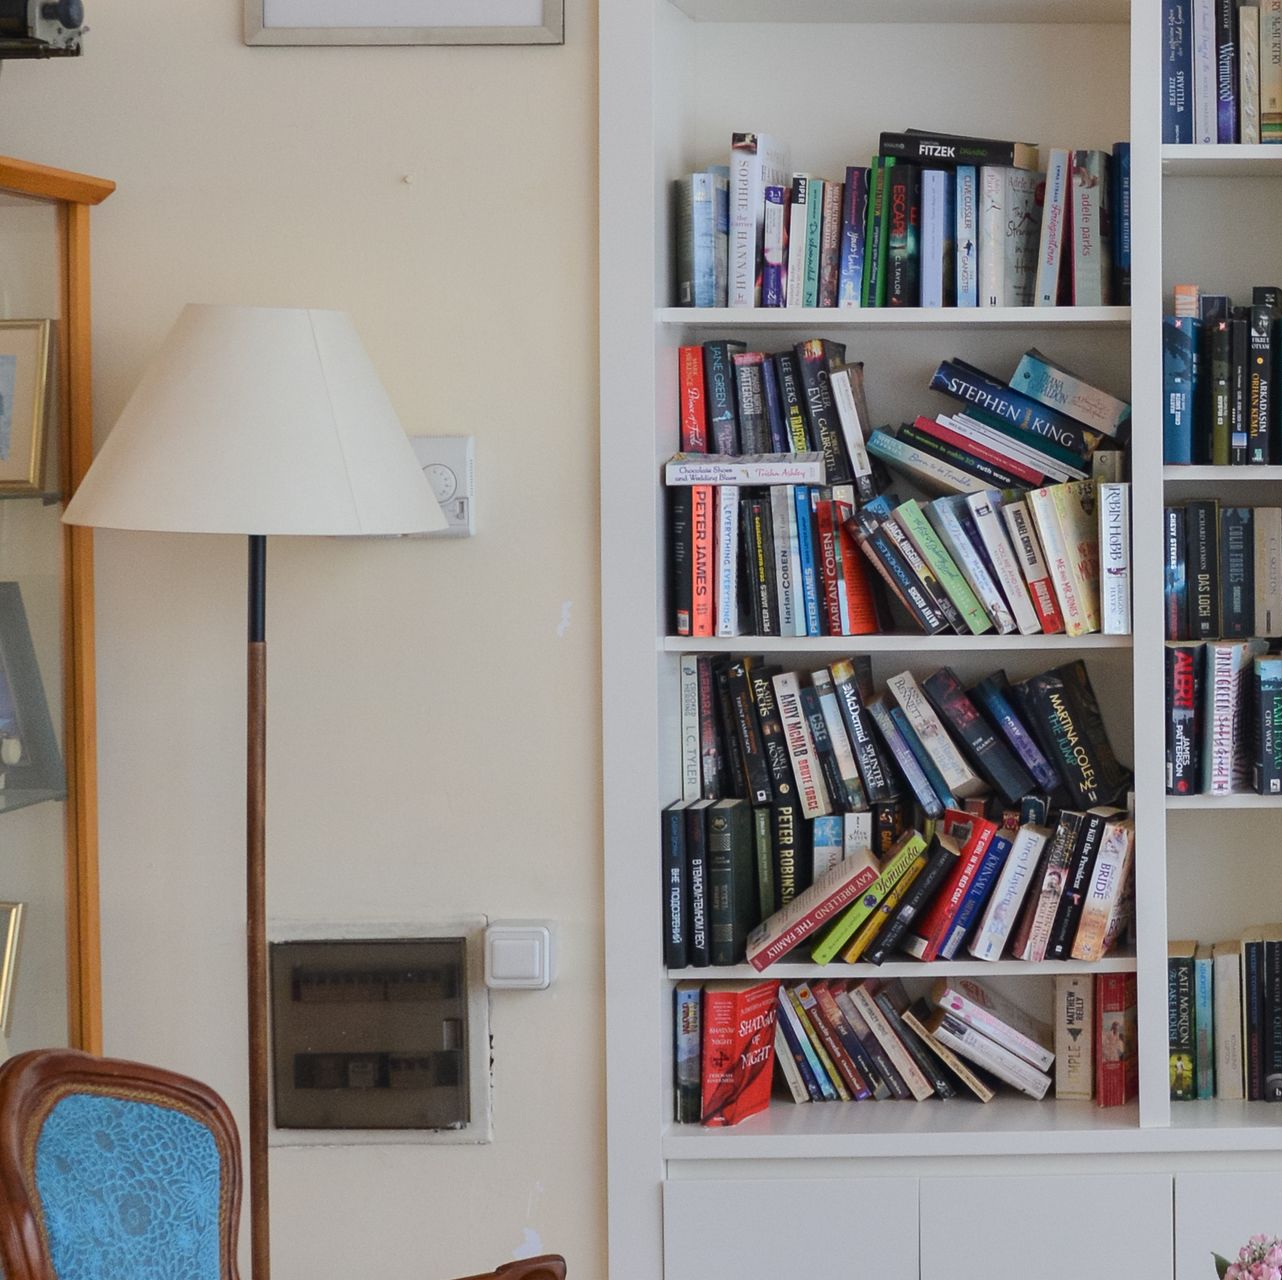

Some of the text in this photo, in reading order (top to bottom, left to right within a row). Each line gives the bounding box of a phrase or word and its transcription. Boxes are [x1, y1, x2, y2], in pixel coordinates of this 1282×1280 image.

[1219, 42, 1234, 102] Wormwood
[919, 144, 955, 158] FITZEK
[739, 160, 749, 212] SOPHIE
[1081, 194, 1092, 256] adele parks
[736, 231, 748, 290] HANNAH
[711, 346, 727, 408] JANE GREEN
[741, 367, 753, 415] PATTERSON
[784, 373, 797, 403] WEEKS
[1252, 373, 1260, 405] ORHAN
[808, 387, 823, 417] EVIL
[948, 378, 1021, 420] STEPHEN
[1032, 419, 1074, 447] KING
[818, 418, 837, 471] GALBRAITH
[976, 463, 1011, 483] ruth ware
[696, 491, 706, 597] PETER JAMES
[886, 521, 923, 571] JACK HIGGINS
[1012, 510, 1037, 566] MICHAEL CRICHTON
[779, 550, 791, 623] Harlan COBEN
[823, 532, 841, 632] HARLAN COBEN
[1198, 574, 1210, 616] DAS LOCH
[810, 603, 818, 633] PETER
[754, 679, 769, 717] REICHS
[845, 688, 869, 743] McDermid
[1050, 694, 1079, 746] MARTINA
[780, 694, 808, 757] ANDY McNAB
[687, 746, 697, 785] TYLER
[864, 743, 885, 789] SPLINTER
[1175, 725, 1183, 777] PATTERSON
[798, 759, 819, 811] BRUTE FORCE
[778, 807, 793, 845] PETER
[855, 873, 873, 888] KAY
[958, 875, 970, 889] RED
[1093, 863, 1111, 900] BRIDE
[768, 920, 814, 959] THE FAMILY
[738, 1008, 777, 1037] SHADOW
[1066, 991, 1075, 1025] MATTHEW
[1075, 997, 1084, 1021] REILLY
[1179, 967, 1190, 1044] KATE MORTON
[741, 1045, 771, 1070] NIGHT
